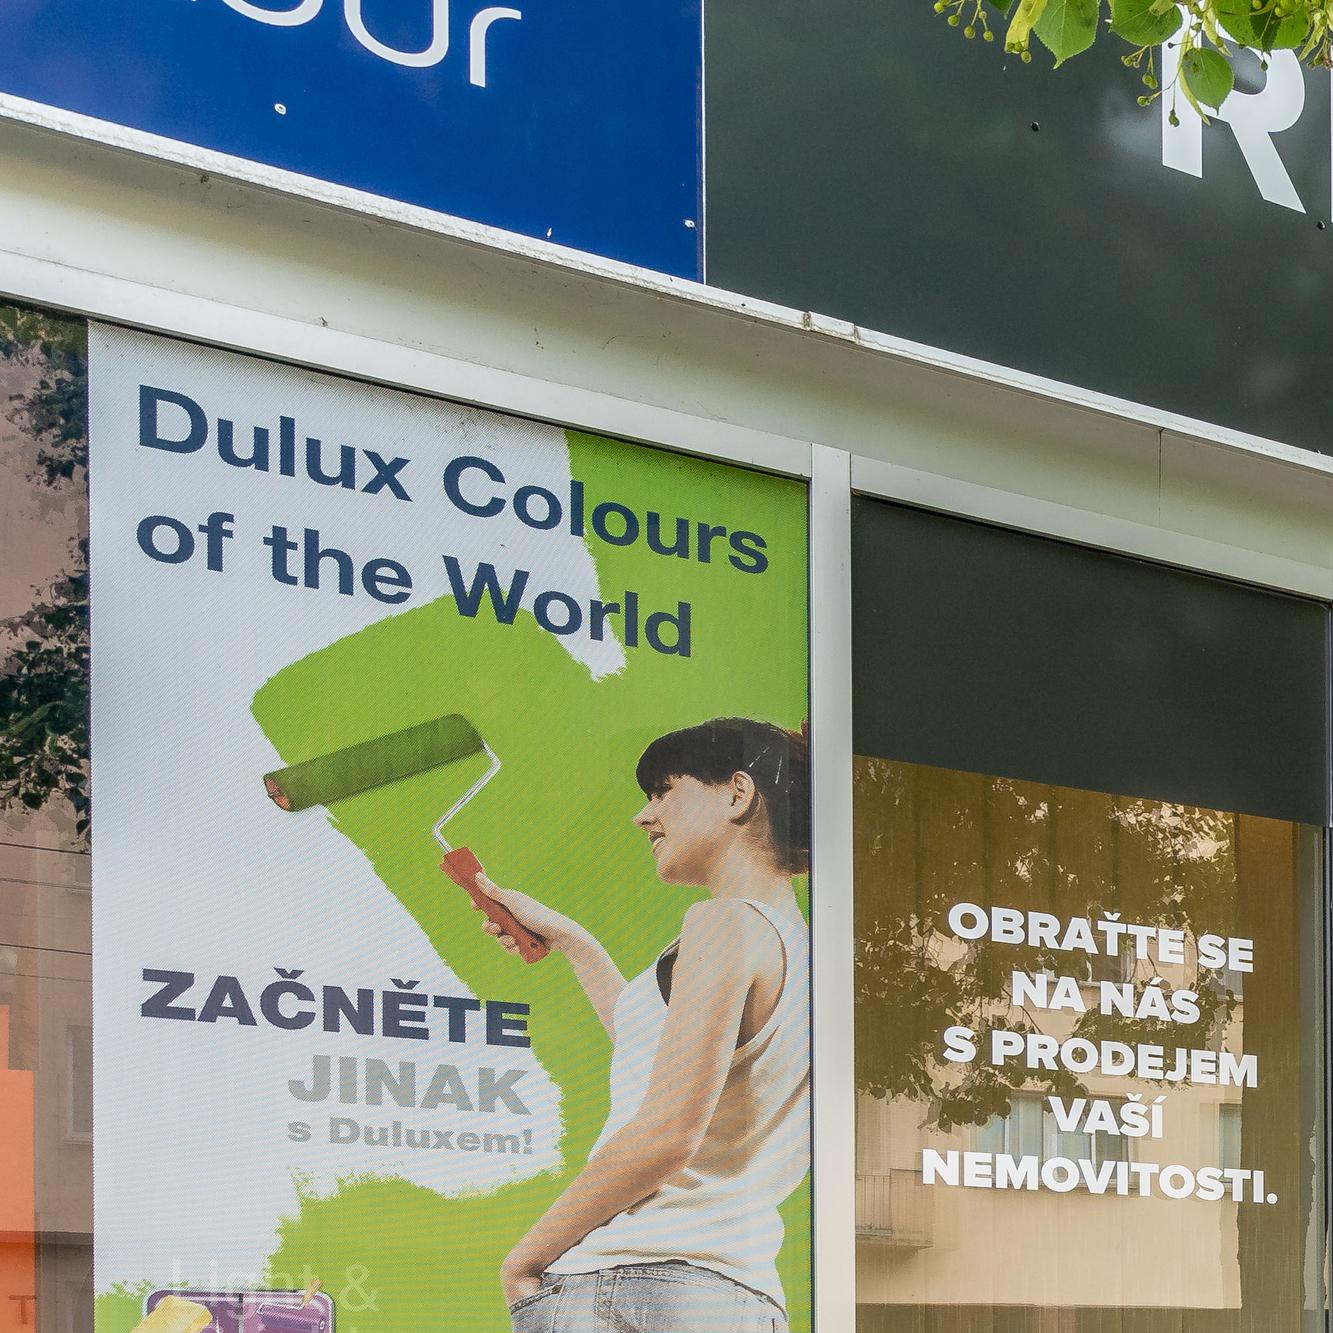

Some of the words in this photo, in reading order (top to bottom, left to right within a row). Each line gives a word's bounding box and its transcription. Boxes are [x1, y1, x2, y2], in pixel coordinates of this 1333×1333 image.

[138, 384, 413, 502] Dulux
[443, 455, 769, 574] Colours
[136, 511, 234, 573] of
[262, 524, 413, 605] the
[443, 552, 692, 659] World
[947, 902, 1185, 964] OBRAŤTE
[1197, 934, 1254, 973] SE
[140, 966, 532, 1049] ZAČNĚTE
[1012, 971, 1085, 1013] NA
[1100, 977, 1200, 1024] NÁS
[287, 1054, 532, 1117] JINAK
[943, 1026, 977, 1063] S
[991, 1030, 1258, 1088] PRODEJEM
[287, 1122, 311, 1144] s
[329, 1118, 534, 1156] Duluxem!
[1048, 1093, 1167, 1138] VAŠÍ
[922, 1148, 1278, 1205] NEMOVITOSTI.
